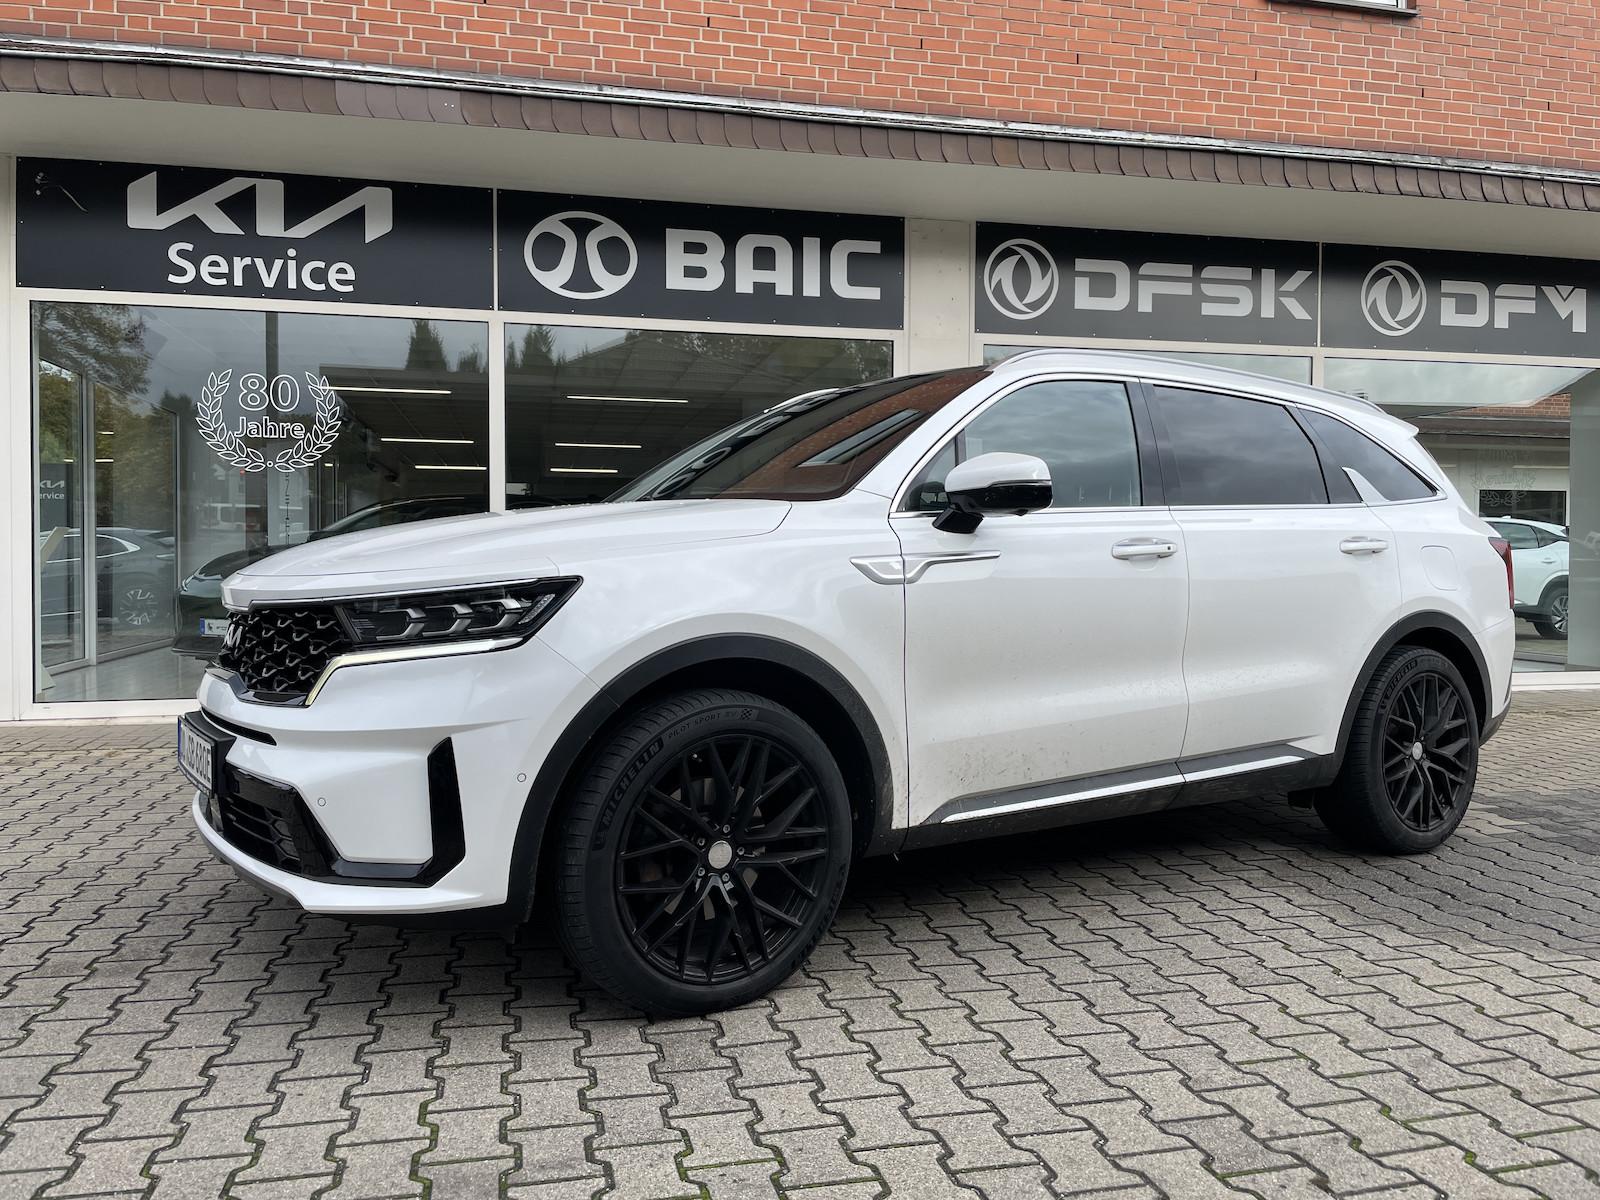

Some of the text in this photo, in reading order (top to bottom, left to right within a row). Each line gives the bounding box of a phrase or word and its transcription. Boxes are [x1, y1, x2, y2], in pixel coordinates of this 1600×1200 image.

[127, 171, 393, 244] KIA
[167, 241, 356, 293] Service
[665, 228, 881, 300] BAIC
[1074, 258, 1313, 320] DFSK
[1440, 280, 1587, 333] DFM
[239, 373, 300, 412] 80
[234, 416, 306, 439] Jahre
[40, 492, 65, 500] rvice
[602, 739, 662, 827] MICHELIN
[694, 712, 721, 726] SPORT
